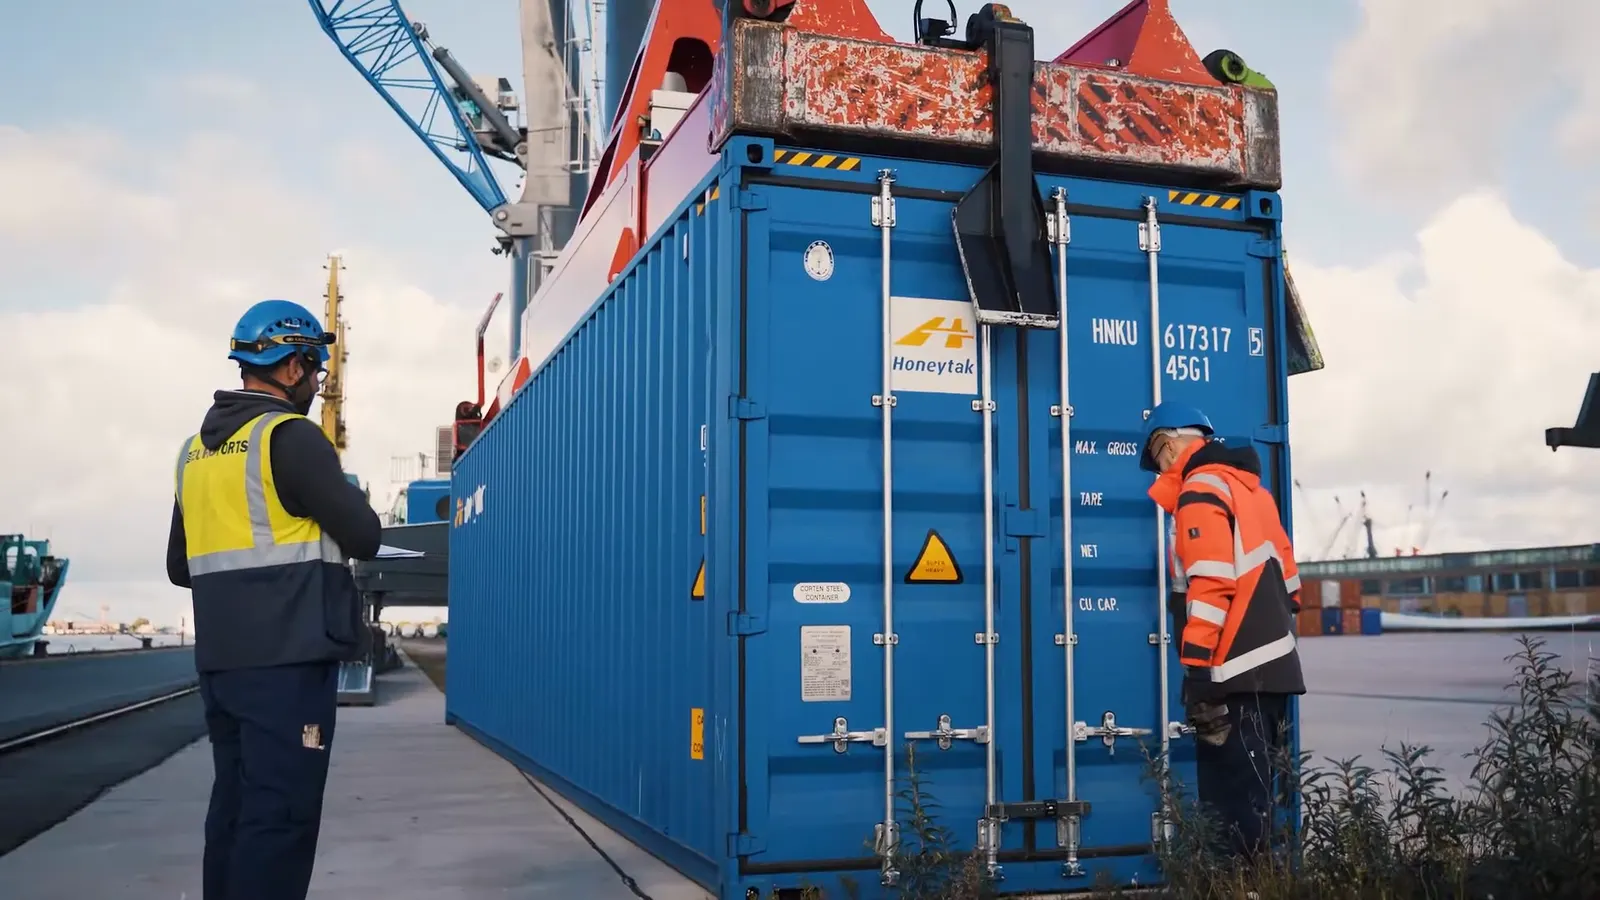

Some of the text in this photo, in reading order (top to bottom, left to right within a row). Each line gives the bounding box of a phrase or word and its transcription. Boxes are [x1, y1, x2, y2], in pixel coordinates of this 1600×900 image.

[1092, 318, 1262, 354] HNKU 617317 5
[893, 356, 974, 375] Honeytak
[1166, 354, 1210, 382] 45G1
[1075, 440, 1138, 456] MAX. GROSS
[1080, 492, 1103, 506] TARE
[1080, 544, 1098, 558] NET
[1079, 598, 1120, 611] CU. CAP.
